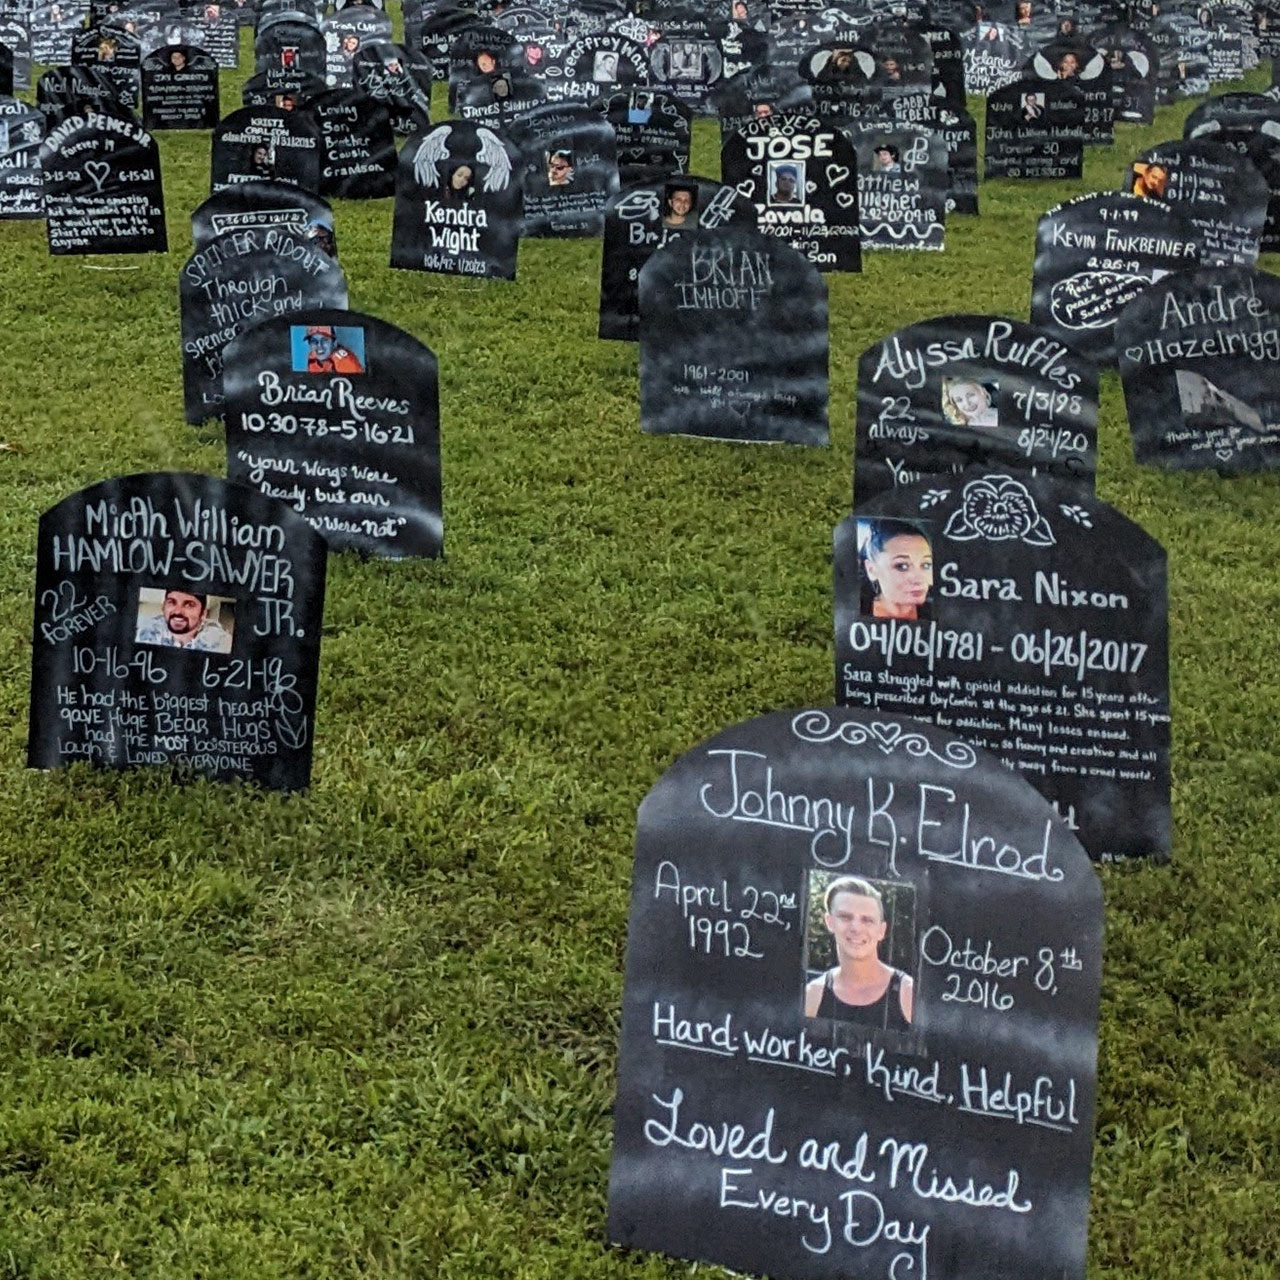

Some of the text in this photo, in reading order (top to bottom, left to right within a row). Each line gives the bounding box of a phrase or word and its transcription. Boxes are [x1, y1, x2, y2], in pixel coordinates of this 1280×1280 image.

[45, 113, 133, 152] DAVID PENCE
[322, 122, 350, 133] Son
[740, 115, 821, 138] FOREVER
[746, 134, 834, 160] JOSE
[323, 164, 384, 177] Grandson
[423, 199, 488, 228] Kendra
[185, 230, 330, 286] SPENCER RIDOUT
[984, 322, 1081, 389] Ruffles
[1148, 329, 1280, 365] Hazelrigg
[258, 371, 411, 420] Brian Reeves
[879, 396, 915, 421] 22
[869, 423, 930, 445] always
[316, 487, 346, 504] but
[175, 498, 285, 552] William
[53, 535, 294, 598] HAMLOW-SAWYER
[940, 562, 1129, 608] Sara Nixon
[41, 580, 87, 623] 22
[849, 620, 1148, 681] 04/06/1981 06/26/2017
[843, 666, 1058, 698] Sara struggled opioid addiction
[1009, 718, 1042, 736] Many
[701, 749, 1065, 883] Johnny K. Elrod
[654, 860, 731, 918] April
[688, 914, 765, 958] 1992
[920, 925, 1029, 978] October
[941, 975, 1016, 1011] 2016
[865, 1042, 954, 1103] Kind,
[960, 1063, 1079, 1125] Helpful
[644, 1086, 1033, 1213] Loved and Missed
[718, 1167, 930, 1280] Every Day
